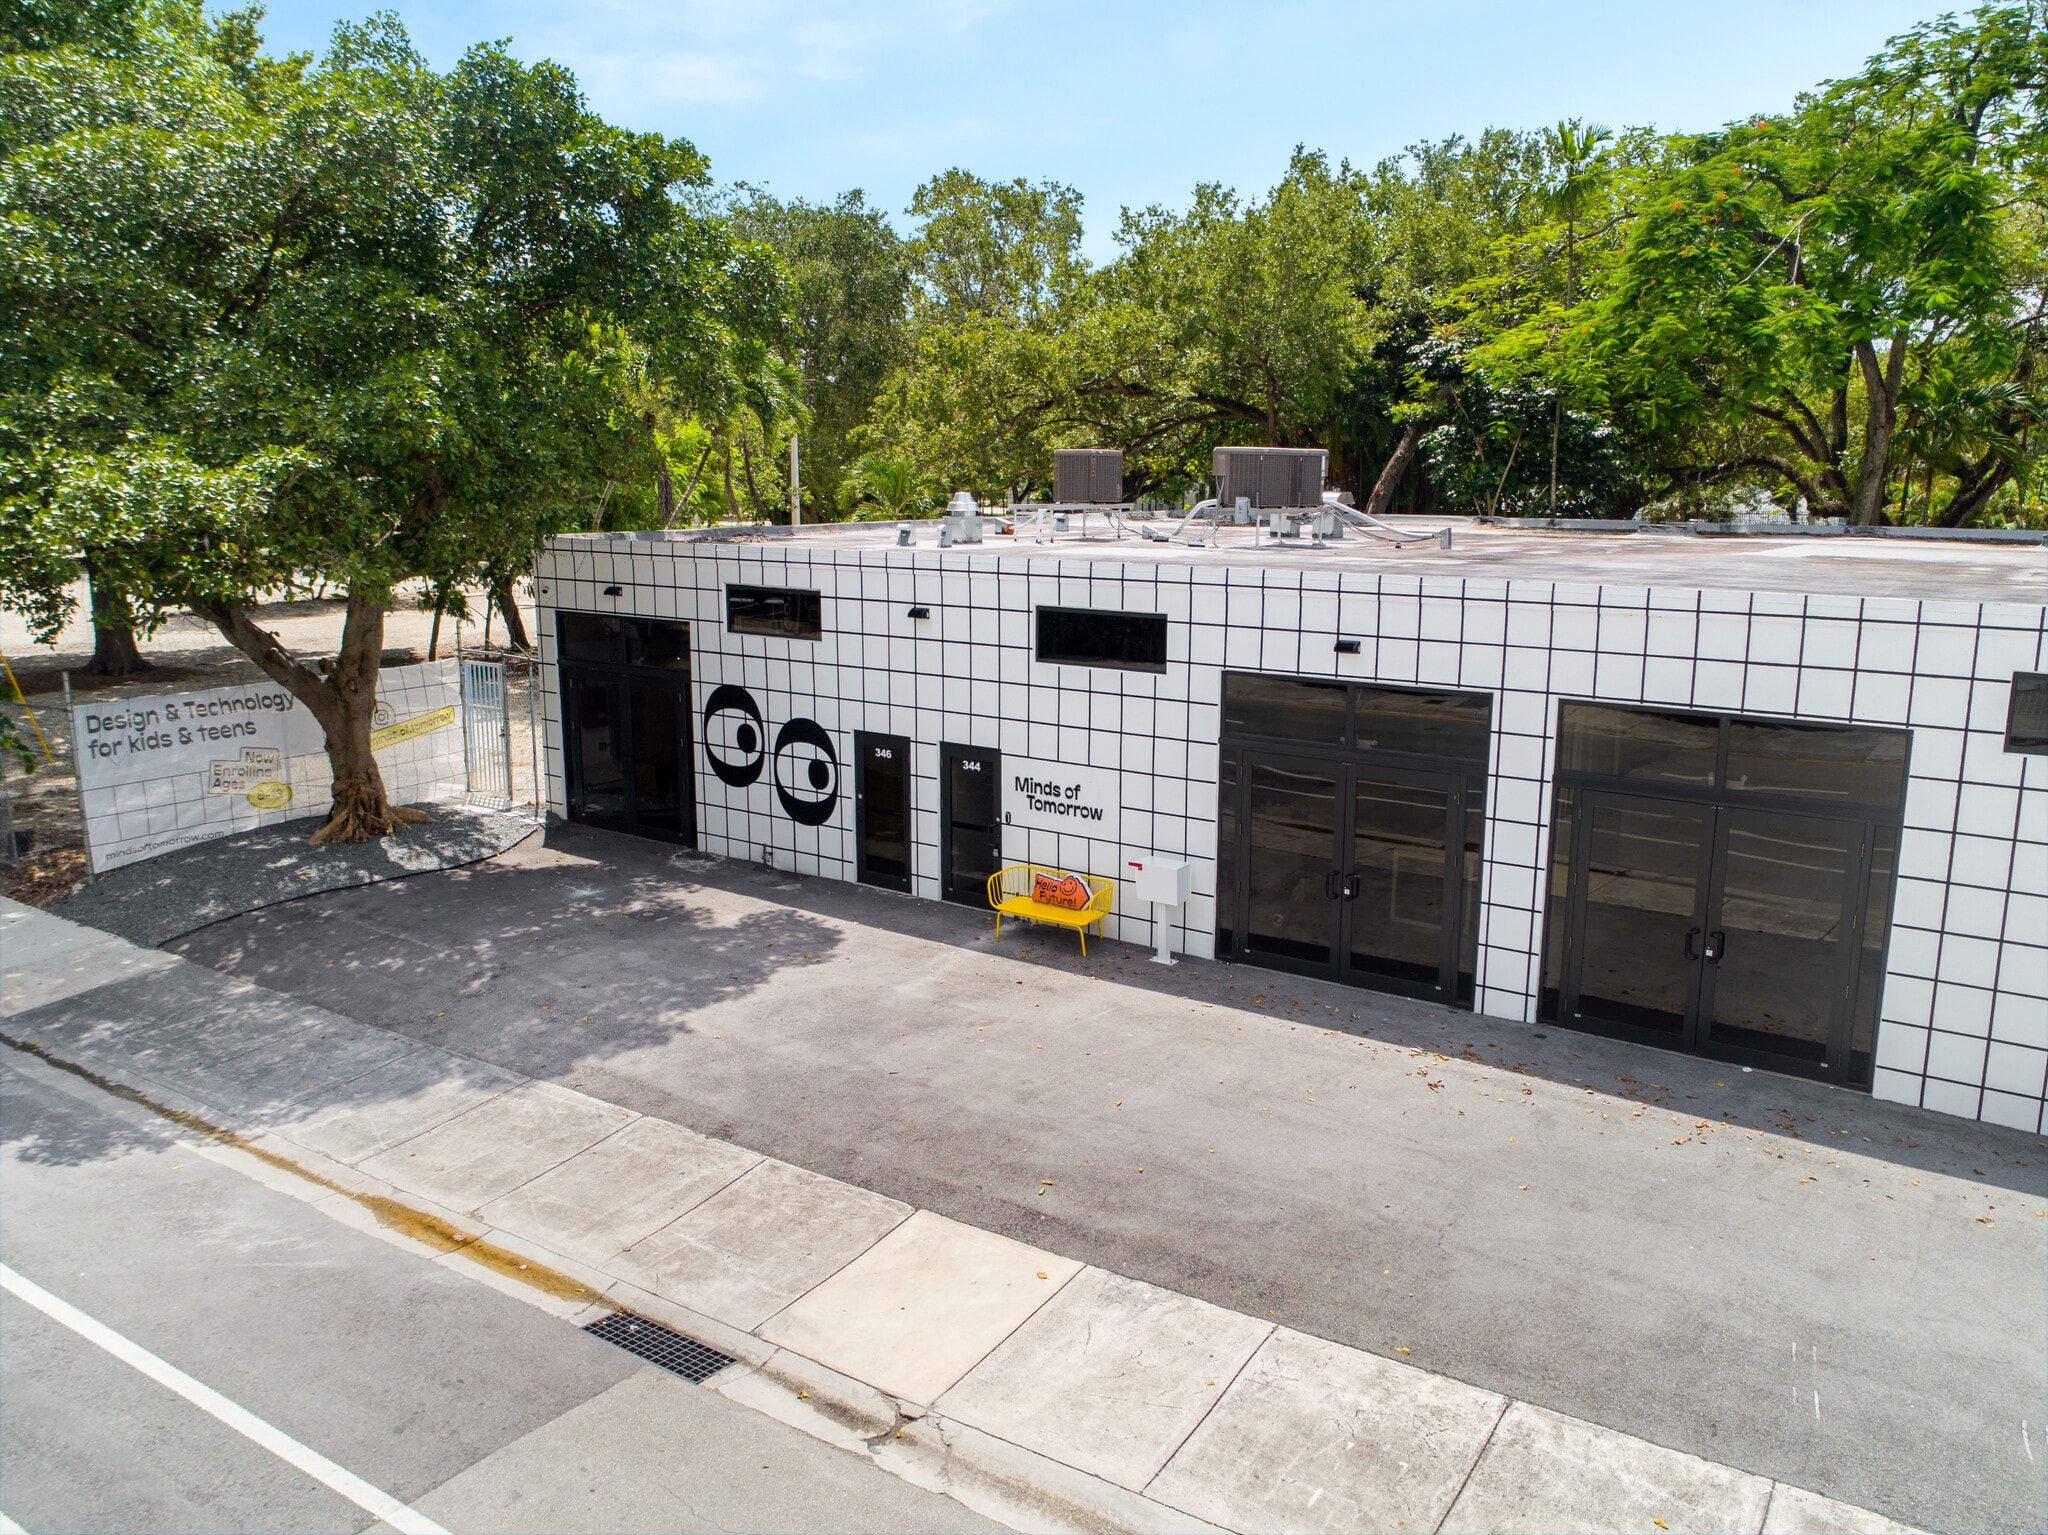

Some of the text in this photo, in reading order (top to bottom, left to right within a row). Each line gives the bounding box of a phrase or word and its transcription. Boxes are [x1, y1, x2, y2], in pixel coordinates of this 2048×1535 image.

[86, 692, 294, 733] Design & Technology
[88, 720, 257, 759] for kids & teens
[244, 751, 275, 764] Now
[874, 748, 893, 760] 346
[962, 760, 982, 772] 344
[212, 777, 247, 793] Ages
[1014, 776, 1082, 800] Minds of
[1026, 794, 1104, 821] Tomorrow
[105, 830, 225, 861] mindsoftomorrow.com
[1034, 878, 1058, 893] Hello
[1039, 890, 1077, 908] Future!
